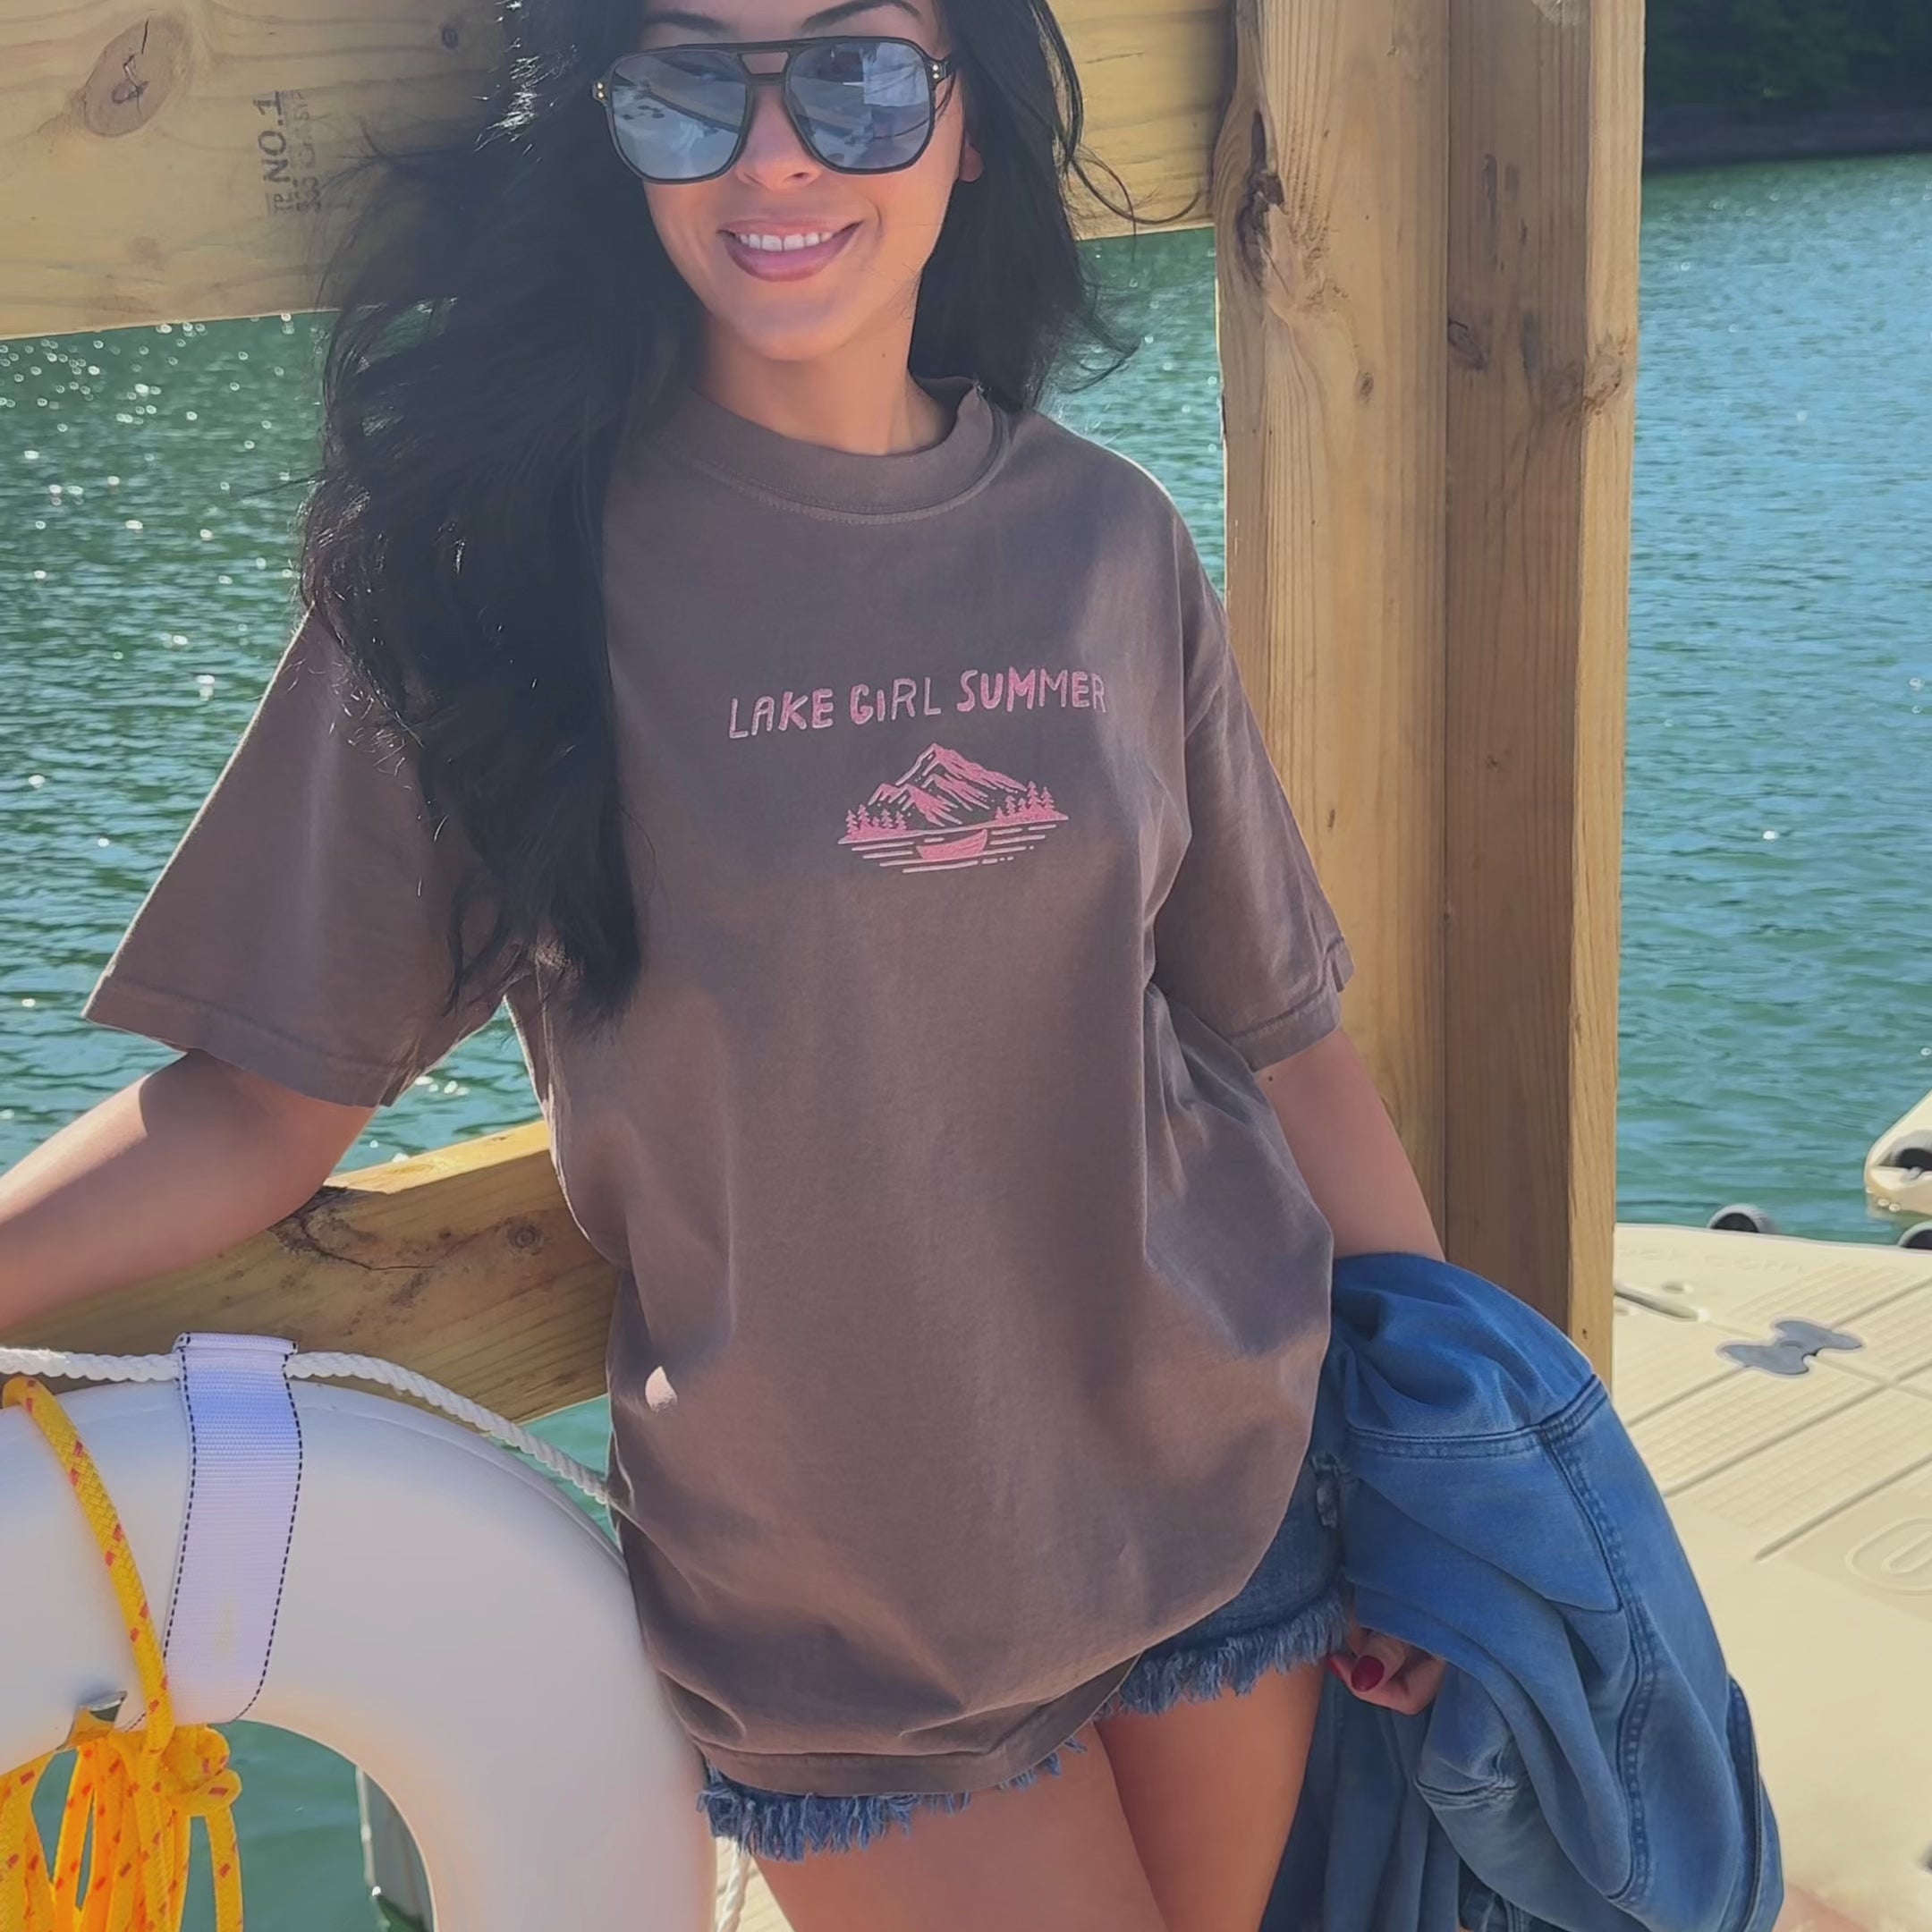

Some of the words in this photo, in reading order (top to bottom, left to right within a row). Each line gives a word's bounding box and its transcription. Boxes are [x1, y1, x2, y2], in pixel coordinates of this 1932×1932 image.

[254, 91, 291, 182] NO.1
[729, 688, 834, 739] LAKE
[850, 676, 941, 724] GIRL
[956, 665, 1106, 713] SUMMER
